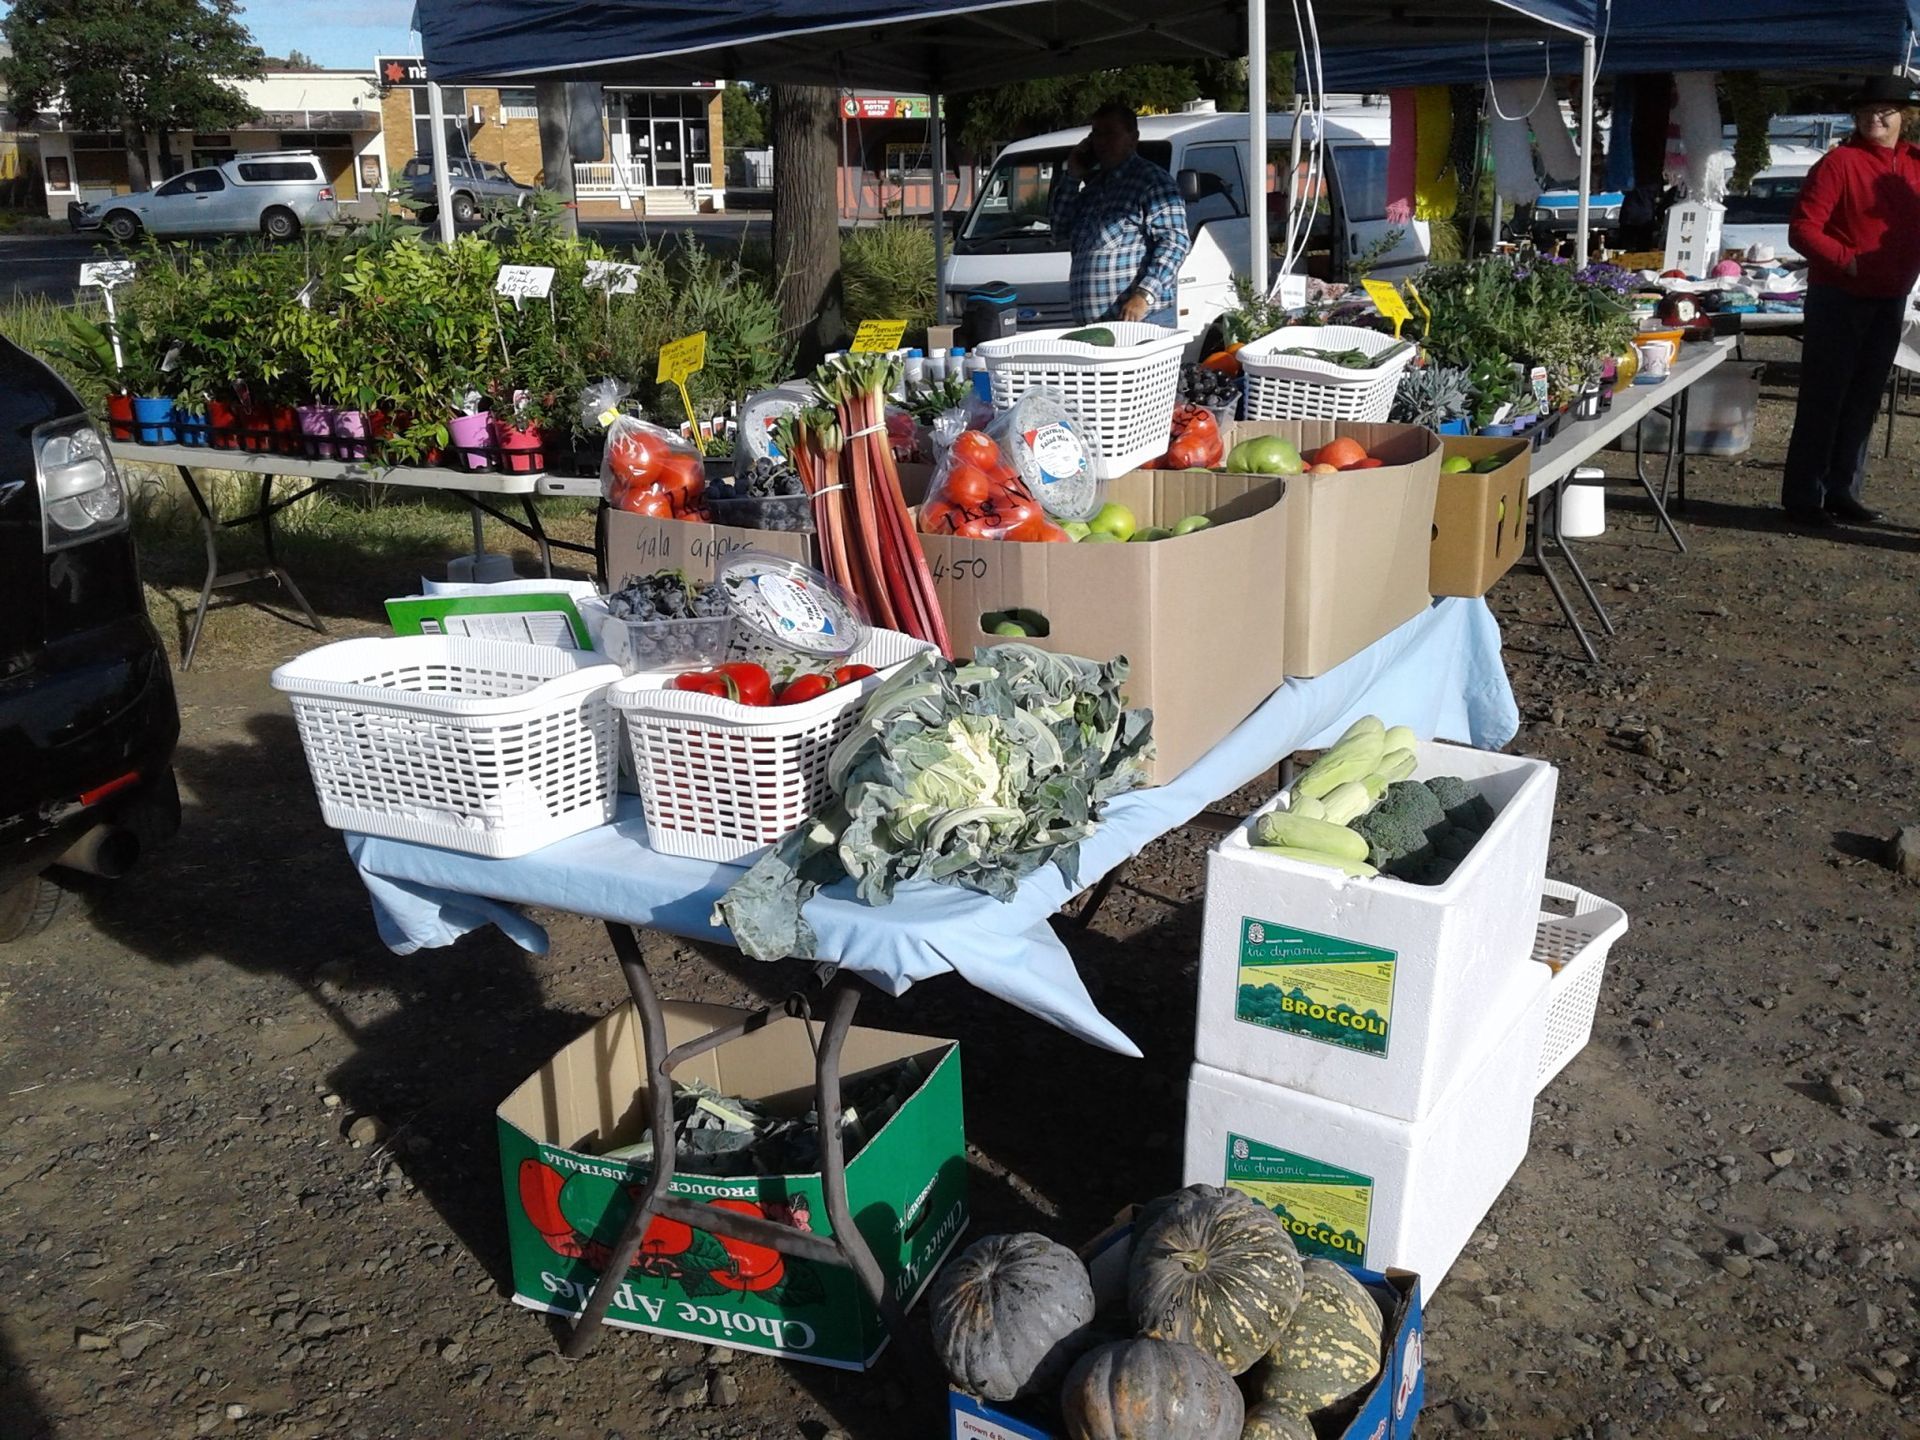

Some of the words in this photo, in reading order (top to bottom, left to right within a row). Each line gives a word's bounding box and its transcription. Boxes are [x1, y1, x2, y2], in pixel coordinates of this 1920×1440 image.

[408, 66, 427, 79] na
[1038, 428, 1065, 441] Gourmet
[1040, 436, 1056, 450] Salad
[636, 527, 670, 564] Gala
[690, 535, 754, 568] apples
[1281, 996, 1386, 1036] BROCCOLI
[543, 1151, 635, 1182] AUSTRALIA
[1254, 1160, 1304, 1176] dynamic
[667, 1181, 758, 1198] PRODUCE
[925, 1200, 963, 1262] Choice
[1280, 1215, 1363, 1256] ROCCOLI
[895, 1255, 922, 1302] App
[540, 1270, 666, 1323] Aples
[678, 1301, 816, 1349] Choice
[963, 1420, 988, 1437] Grown
[990, 1431, 996, 1440] &
